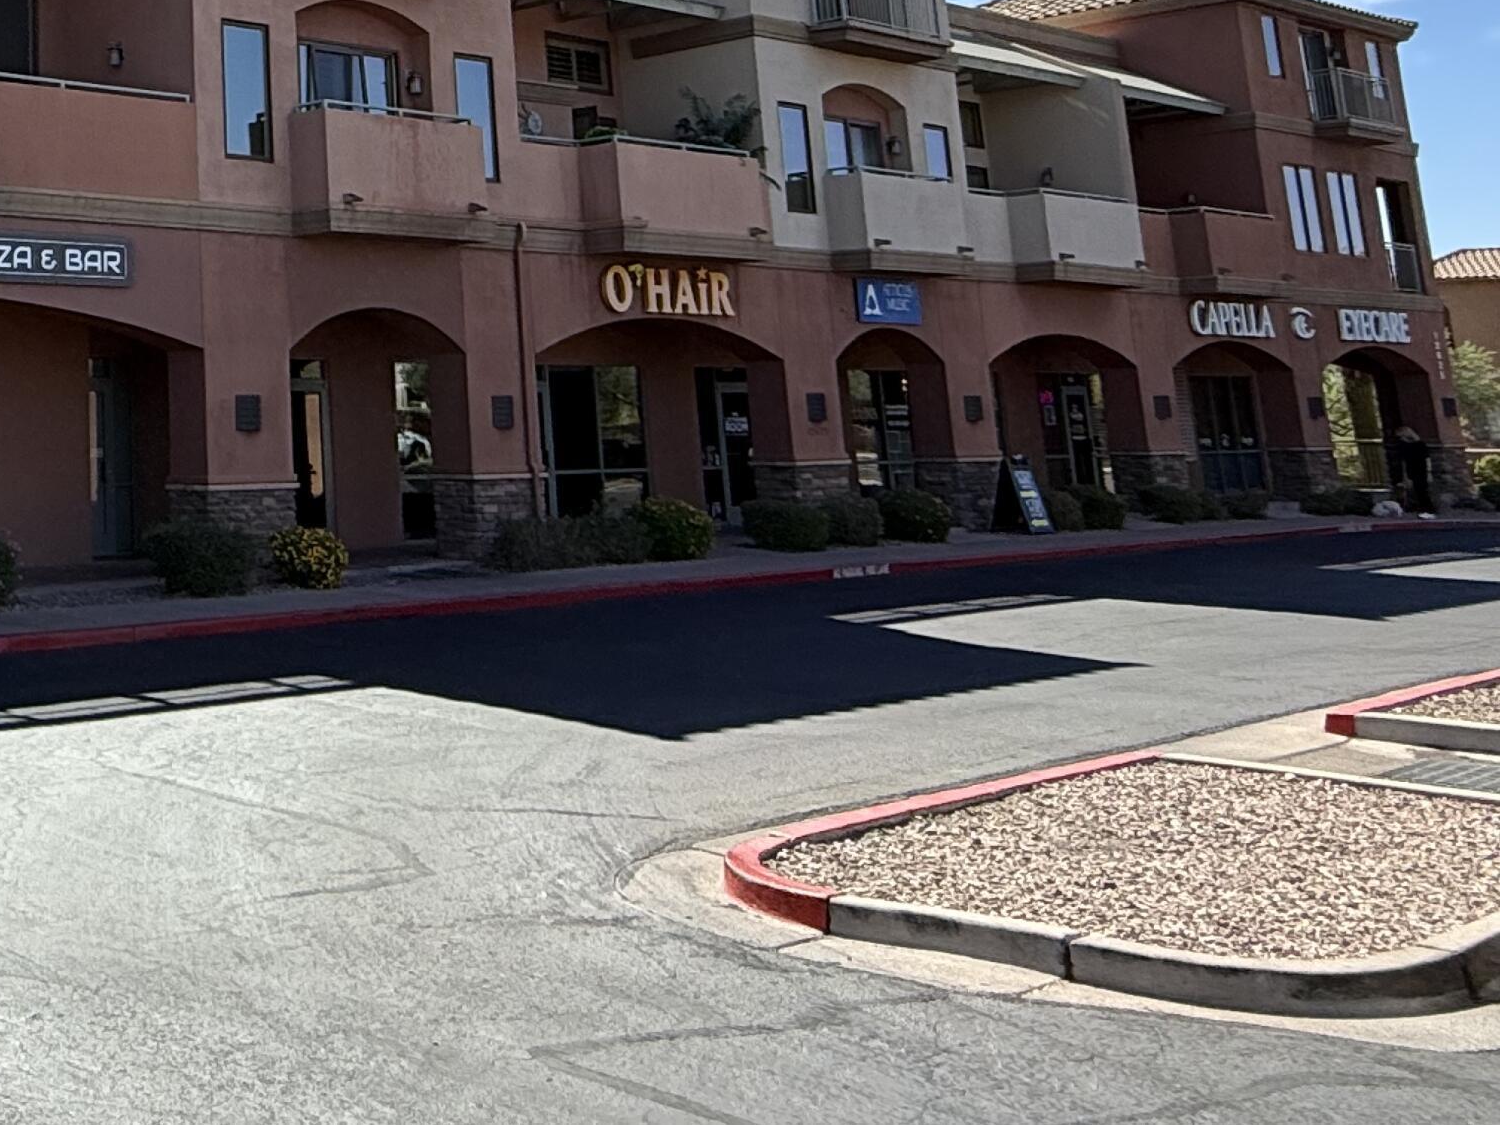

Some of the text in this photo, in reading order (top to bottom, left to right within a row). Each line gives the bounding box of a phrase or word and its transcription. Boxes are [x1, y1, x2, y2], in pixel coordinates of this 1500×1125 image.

[41, 248, 58, 271] &
[65, 250, 123, 274] BAR
[1189, 300, 1276, 339] CAPELLA
[1337, 308, 1412, 344] EYECARE
